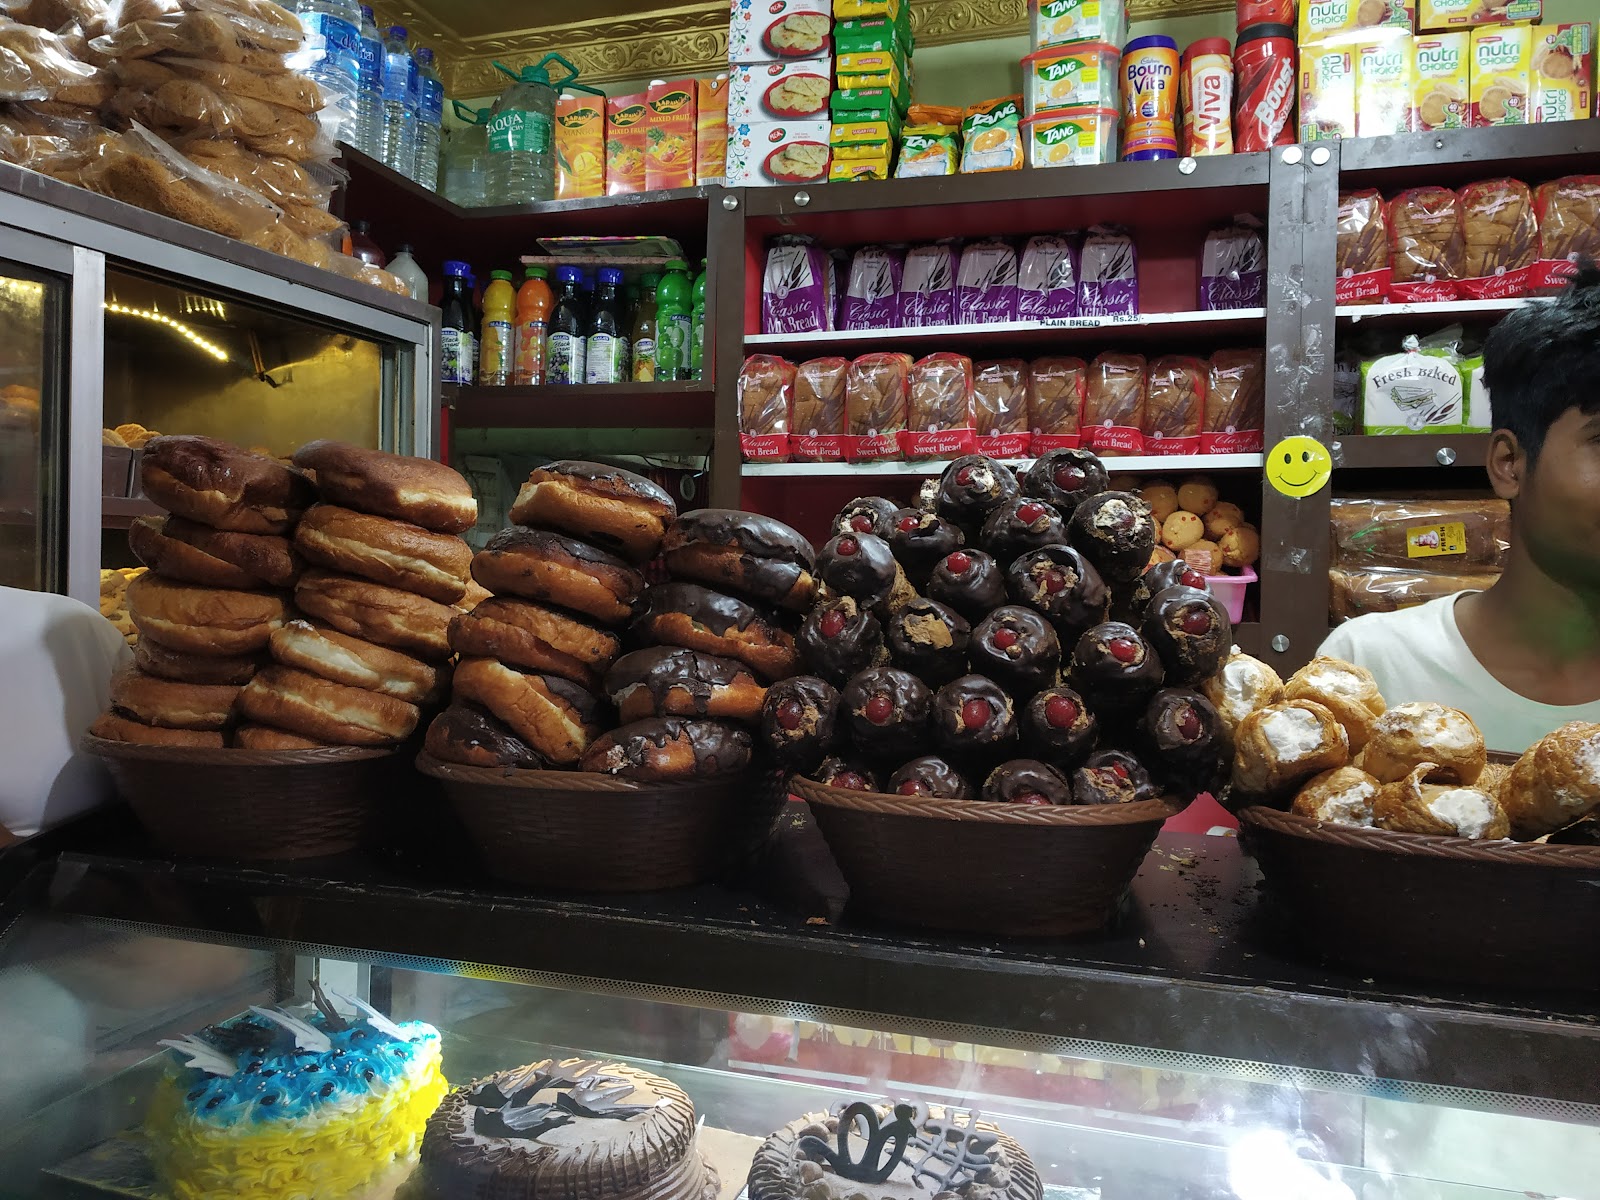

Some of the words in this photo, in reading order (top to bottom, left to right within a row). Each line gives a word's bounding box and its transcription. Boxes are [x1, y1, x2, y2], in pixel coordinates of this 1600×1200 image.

[1047, 0, 1077, 17] TANG
[1310, 2, 1348, 17] nutri
[1419, 47, 1459, 63] nutri
[1479, 41, 1520, 57] nutri
[1363, 53, 1403, 67] nutri
[1045, 61, 1076, 80] TANG
[1128, 64, 1172, 80] Bourn
[1134, 75, 1165, 95] Vita
[1198, 75, 1221, 132] Viva
[650, 115, 671, 123] MIXED
[672, 113, 691, 121] FRUIT
[970, 103, 1017, 125] TANG
[487, 113, 524, 137] AQUA
[563, 128, 595, 137] MANGO
[1043, 126, 1074, 145] TANG
[902, 135, 937, 148] TAN
[960, 291, 1011, 311] Classic
[787, 311, 819, 333] Bread
[1040, 319, 1067, 327] PLAIN
[1069, 319, 1101, 327] BREAD
[1373, 367, 1412, 389] Fresh
[917, 433, 958, 444] Classic
[981, 438, 1019, 447] Classic
[1033, 438, 1061, 447] lassic
[1110, 439, 1133, 449] Bread
[758, 447, 779, 456] Bread
[820, 447, 841, 456] Bread
[856, 447, 878, 456] Sweet
[914, 445, 937, 453] Sweet
[939, 442, 962, 451] Bread
[978, 448, 1000, 456] Sweet
[1001, 445, 1023, 455] Bread
[1209, 445, 1234, 454] Sweet
